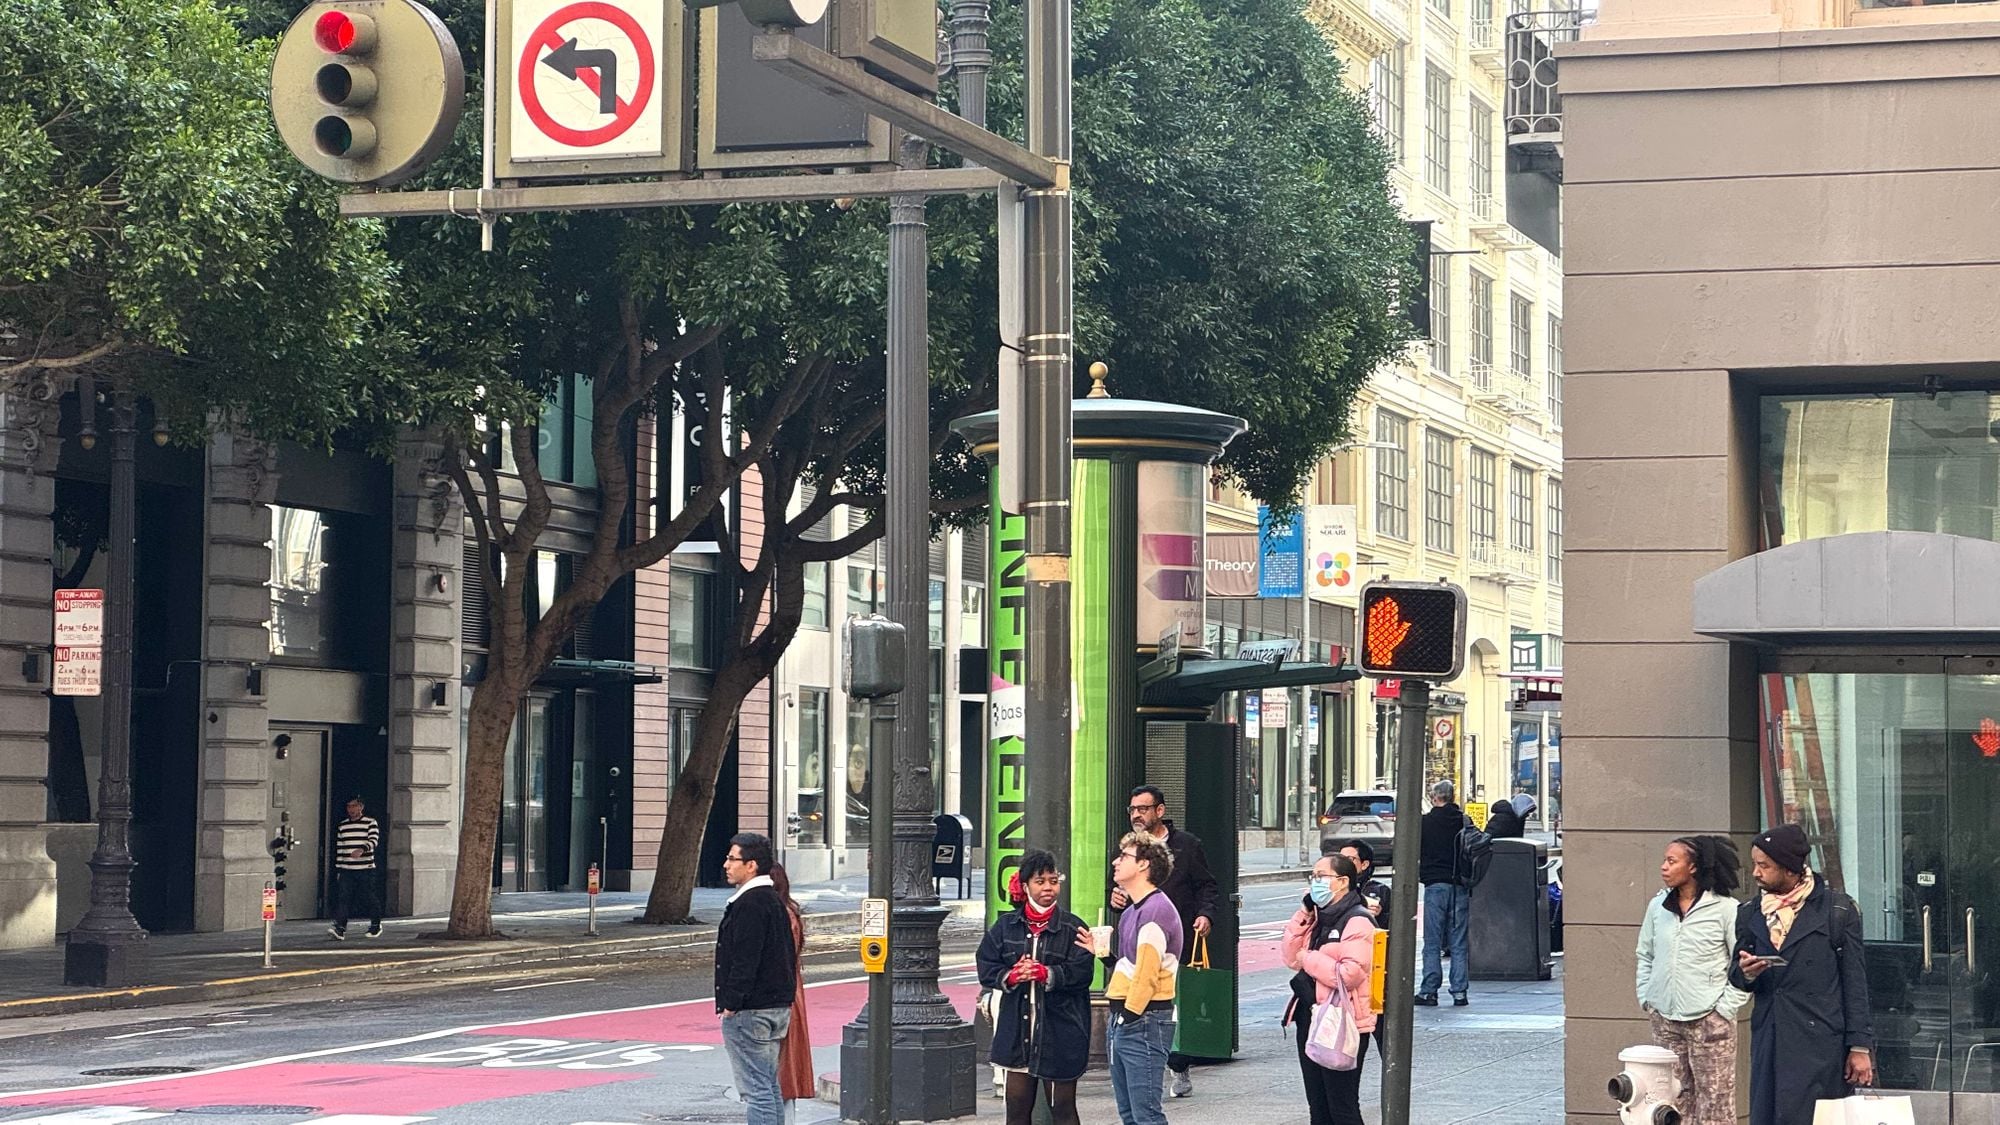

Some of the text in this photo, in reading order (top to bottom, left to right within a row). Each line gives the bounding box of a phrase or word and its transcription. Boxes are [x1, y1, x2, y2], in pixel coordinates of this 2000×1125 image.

[1206, 559, 1257, 574] Theory
[60, 591, 98, 600] TOW-AWAY
[57, 600, 102, 611] NO STOPPING
[57, 648, 101, 661] NO PARKING
[383, 1038, 715, 1070] BUS
